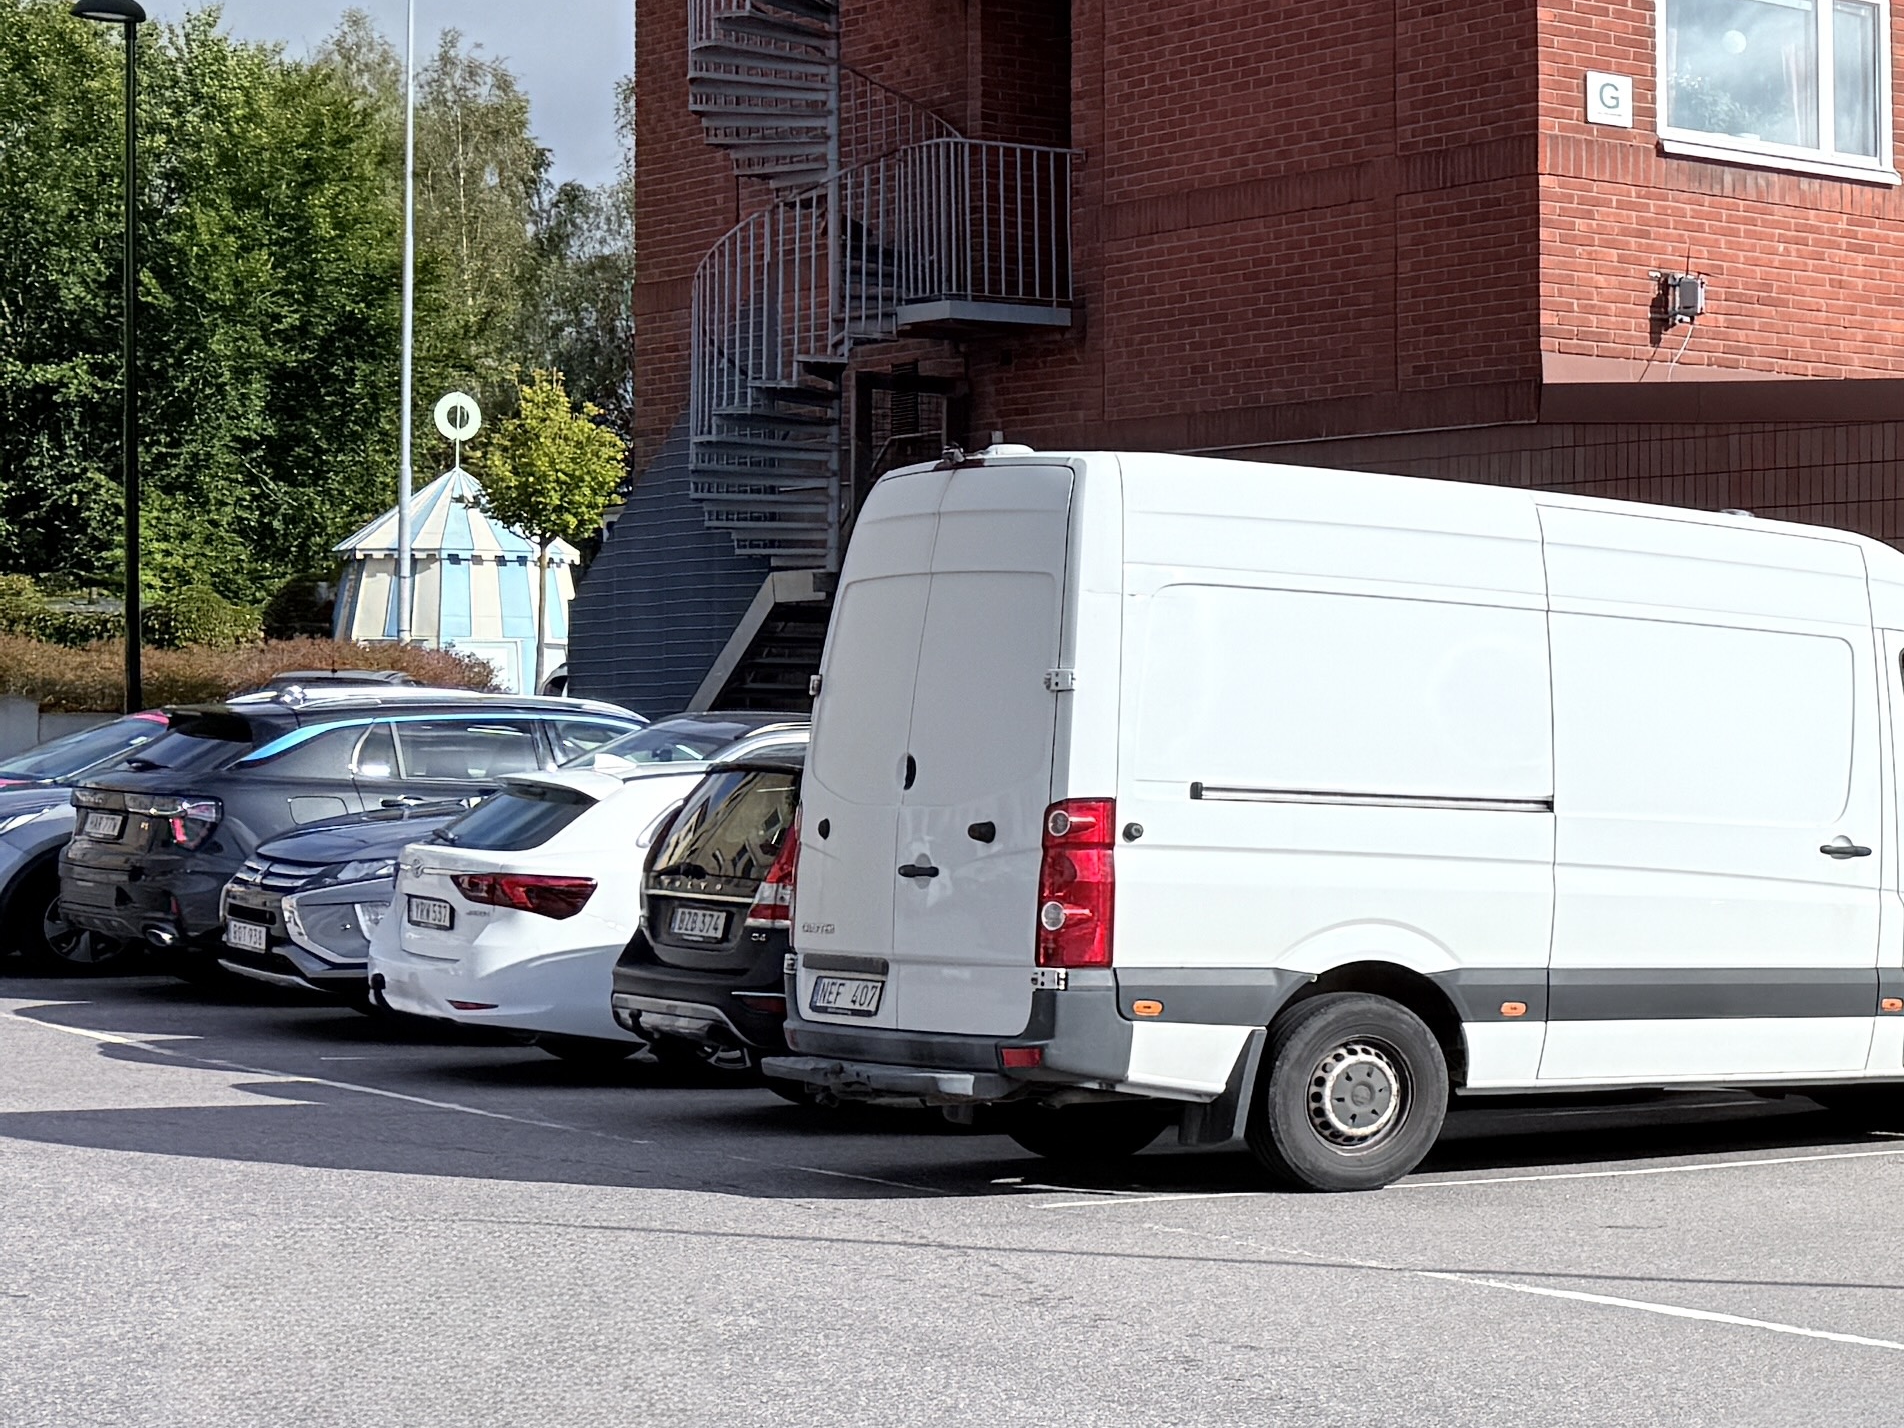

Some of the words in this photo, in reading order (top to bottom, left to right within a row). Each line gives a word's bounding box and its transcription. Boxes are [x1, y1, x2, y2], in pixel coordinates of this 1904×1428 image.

[1599, 82, 1620, 110] G
[431, 903, 448, 923] 537
[699, 913, 720, 934] 374
[819, 981, 845, 1005] NEF
[850, 982, 878, 1007] 407
